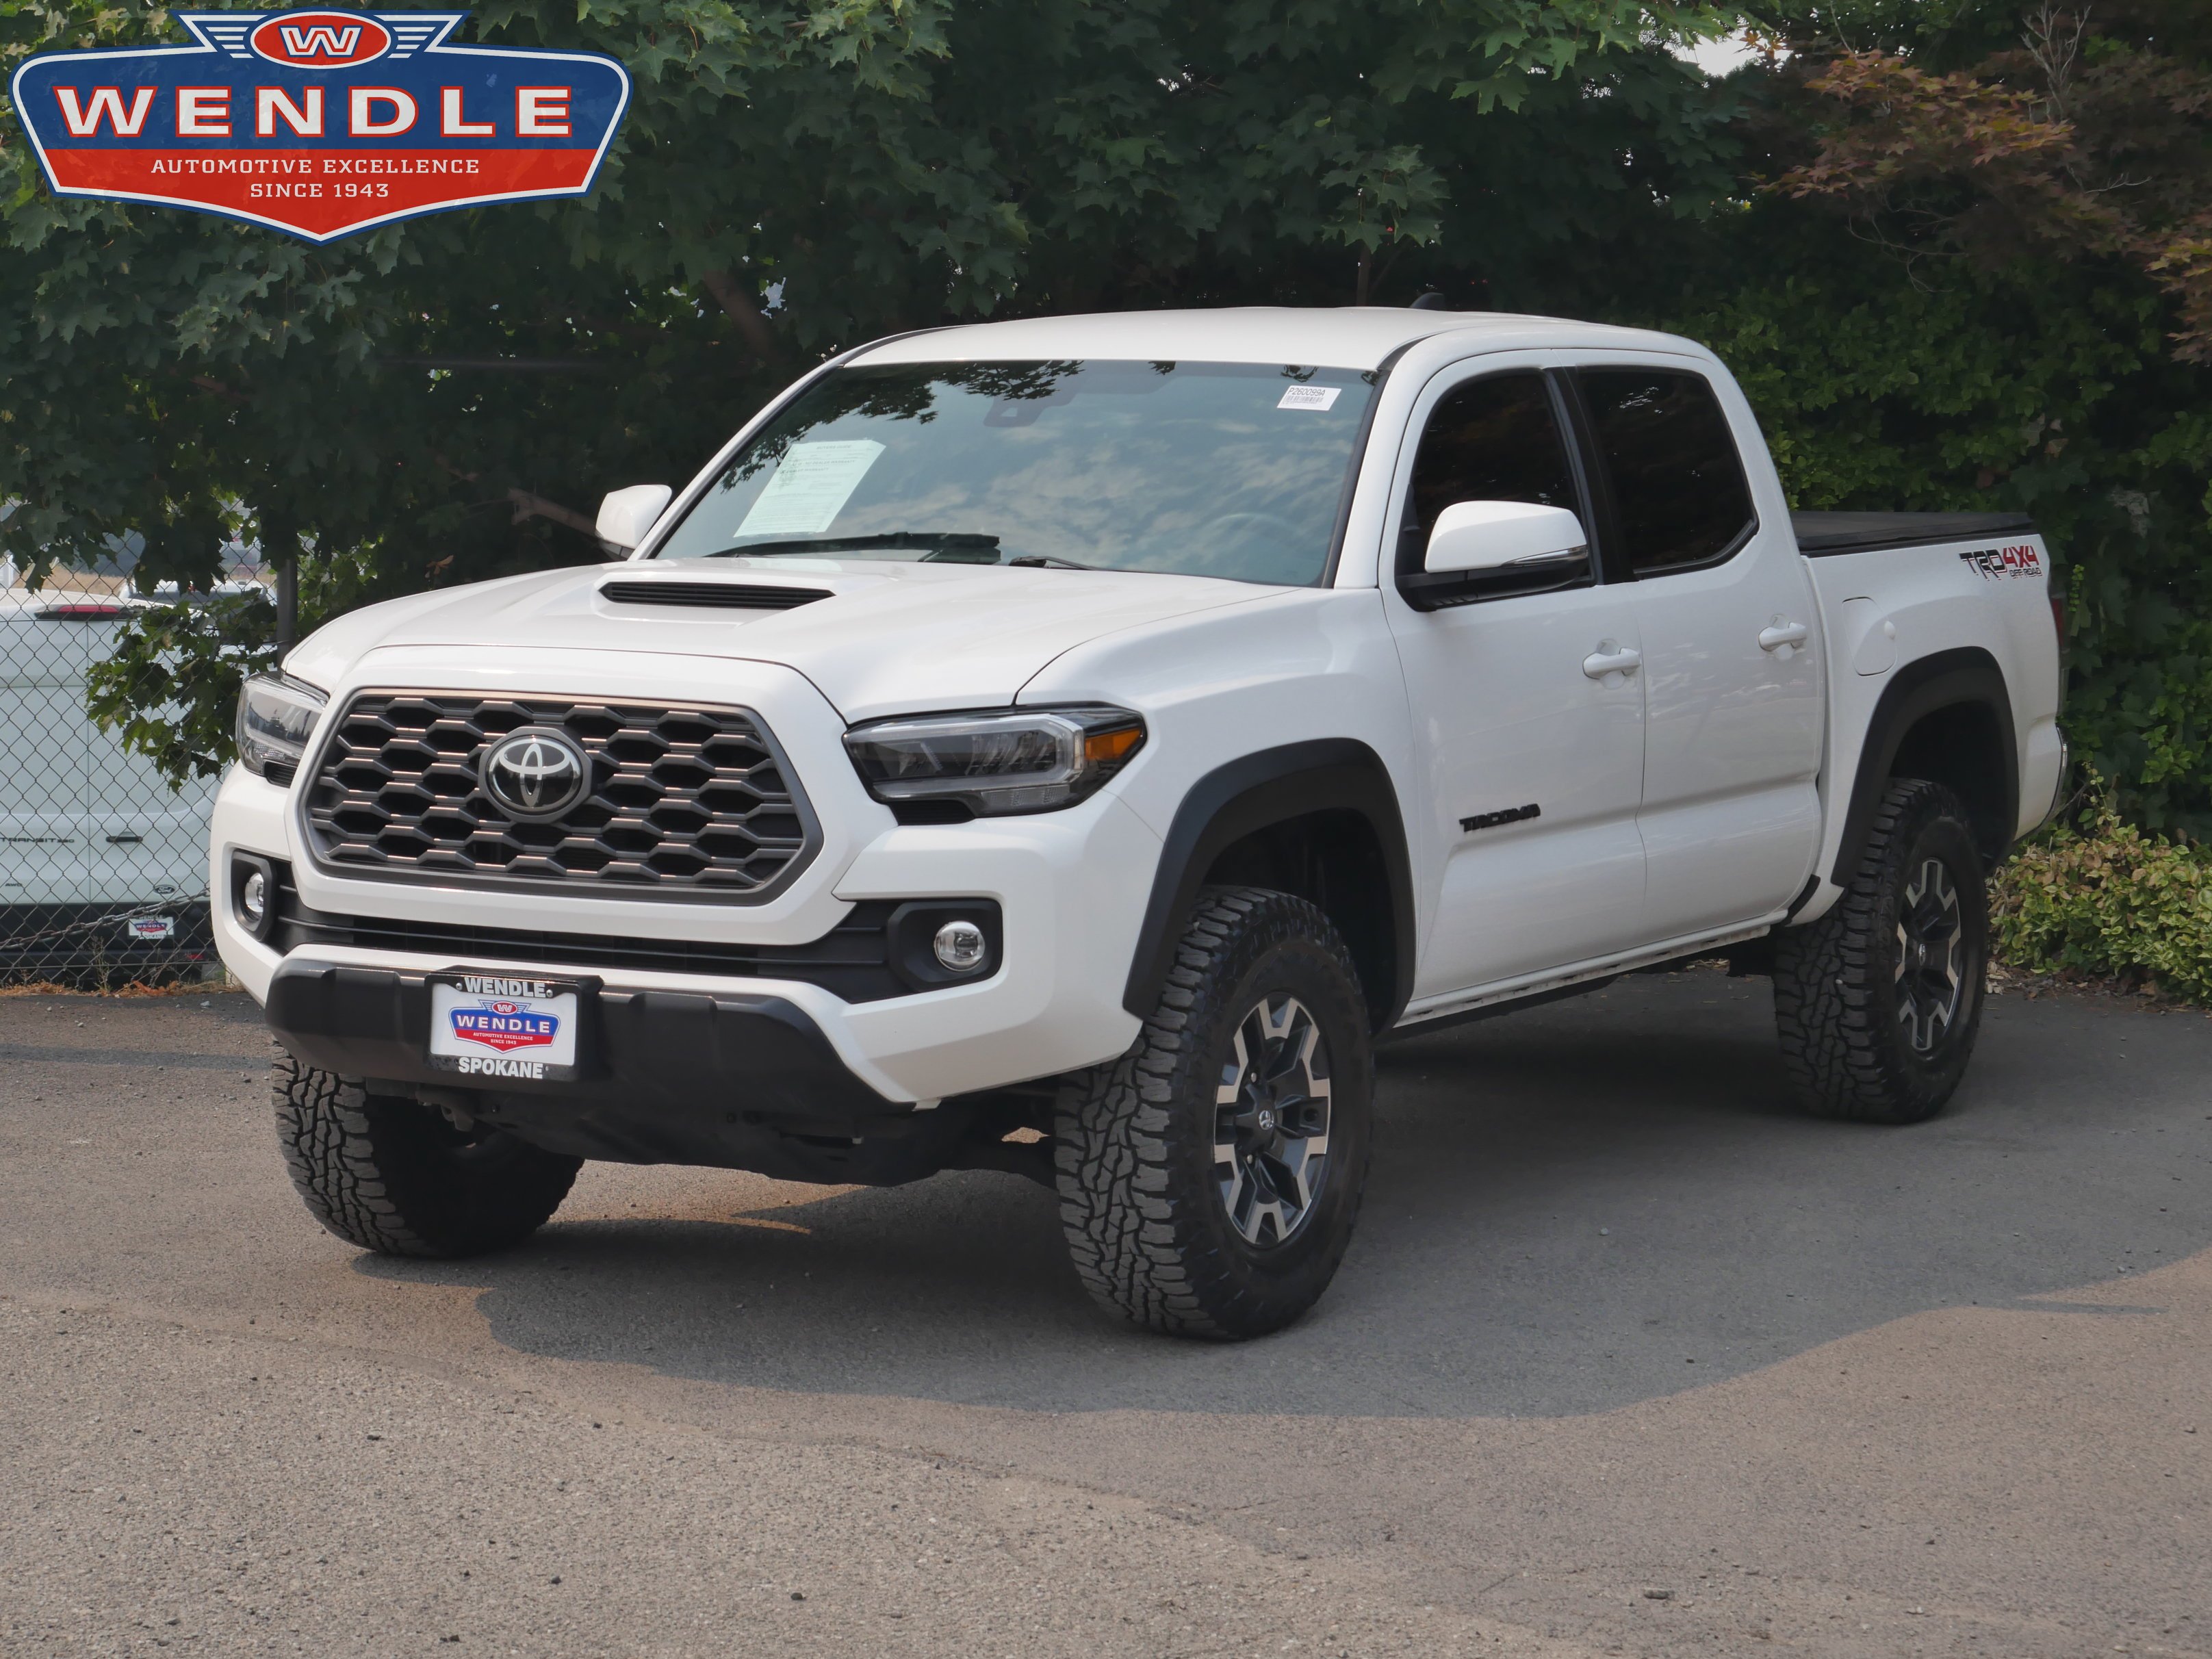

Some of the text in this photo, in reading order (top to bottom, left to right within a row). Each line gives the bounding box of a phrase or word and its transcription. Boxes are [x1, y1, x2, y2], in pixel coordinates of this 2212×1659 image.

[1287, 387, 1326, 396] P260099A
[1959, 550, 2008, 581] TRD
[2024, 567, 2042, 577] ROAD
[464, 977, 546, 998] WENDLE
[456, 1015, 550, 1033] WENDLE
[459, 1057, 543, 1079] SPOKANE
